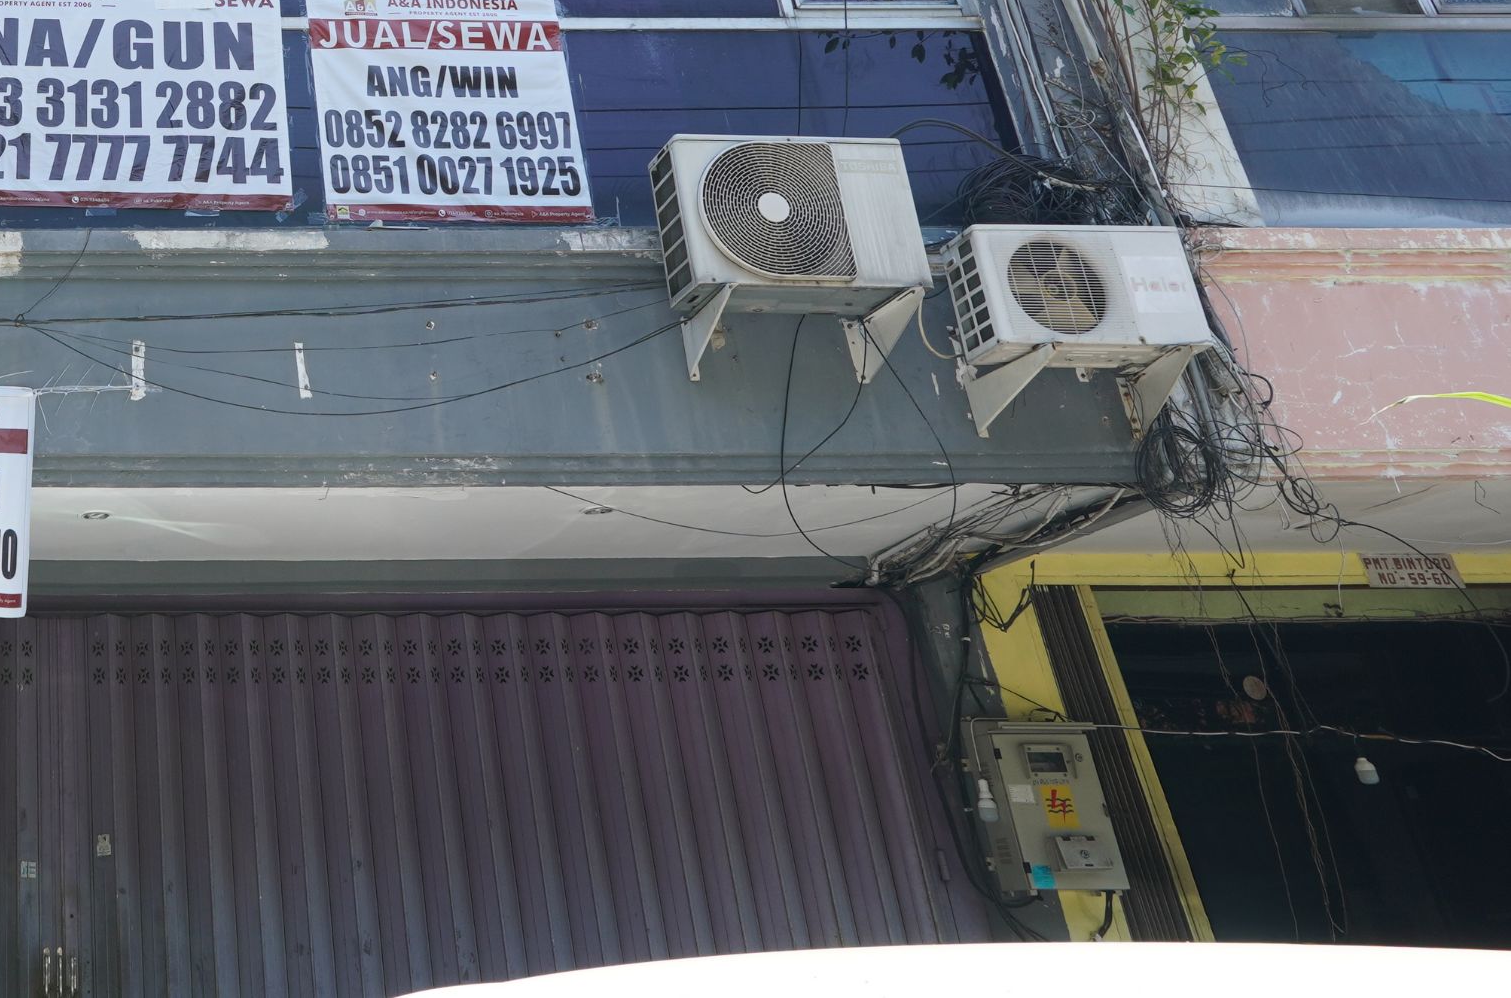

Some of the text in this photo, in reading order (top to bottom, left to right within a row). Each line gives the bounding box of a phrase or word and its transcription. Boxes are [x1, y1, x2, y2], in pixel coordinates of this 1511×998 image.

[30, 0, 56, 8] AGENT
[319, 20, 553, 50] JUAL/SEWA
[367, 65, 519, 98] ANG/WIN
[36, 79, 142, 130] 3131
[156, 80, 277, 132] 2882
[325, 110, 572, 150] 0852 8282 6997
[45, 133, 155, 183] 7777
[162, 134, 285, 185] 7744
[330, 154, 580, 197] 0851 0027 1925
[1130, 276, 1187, 292] Haier
